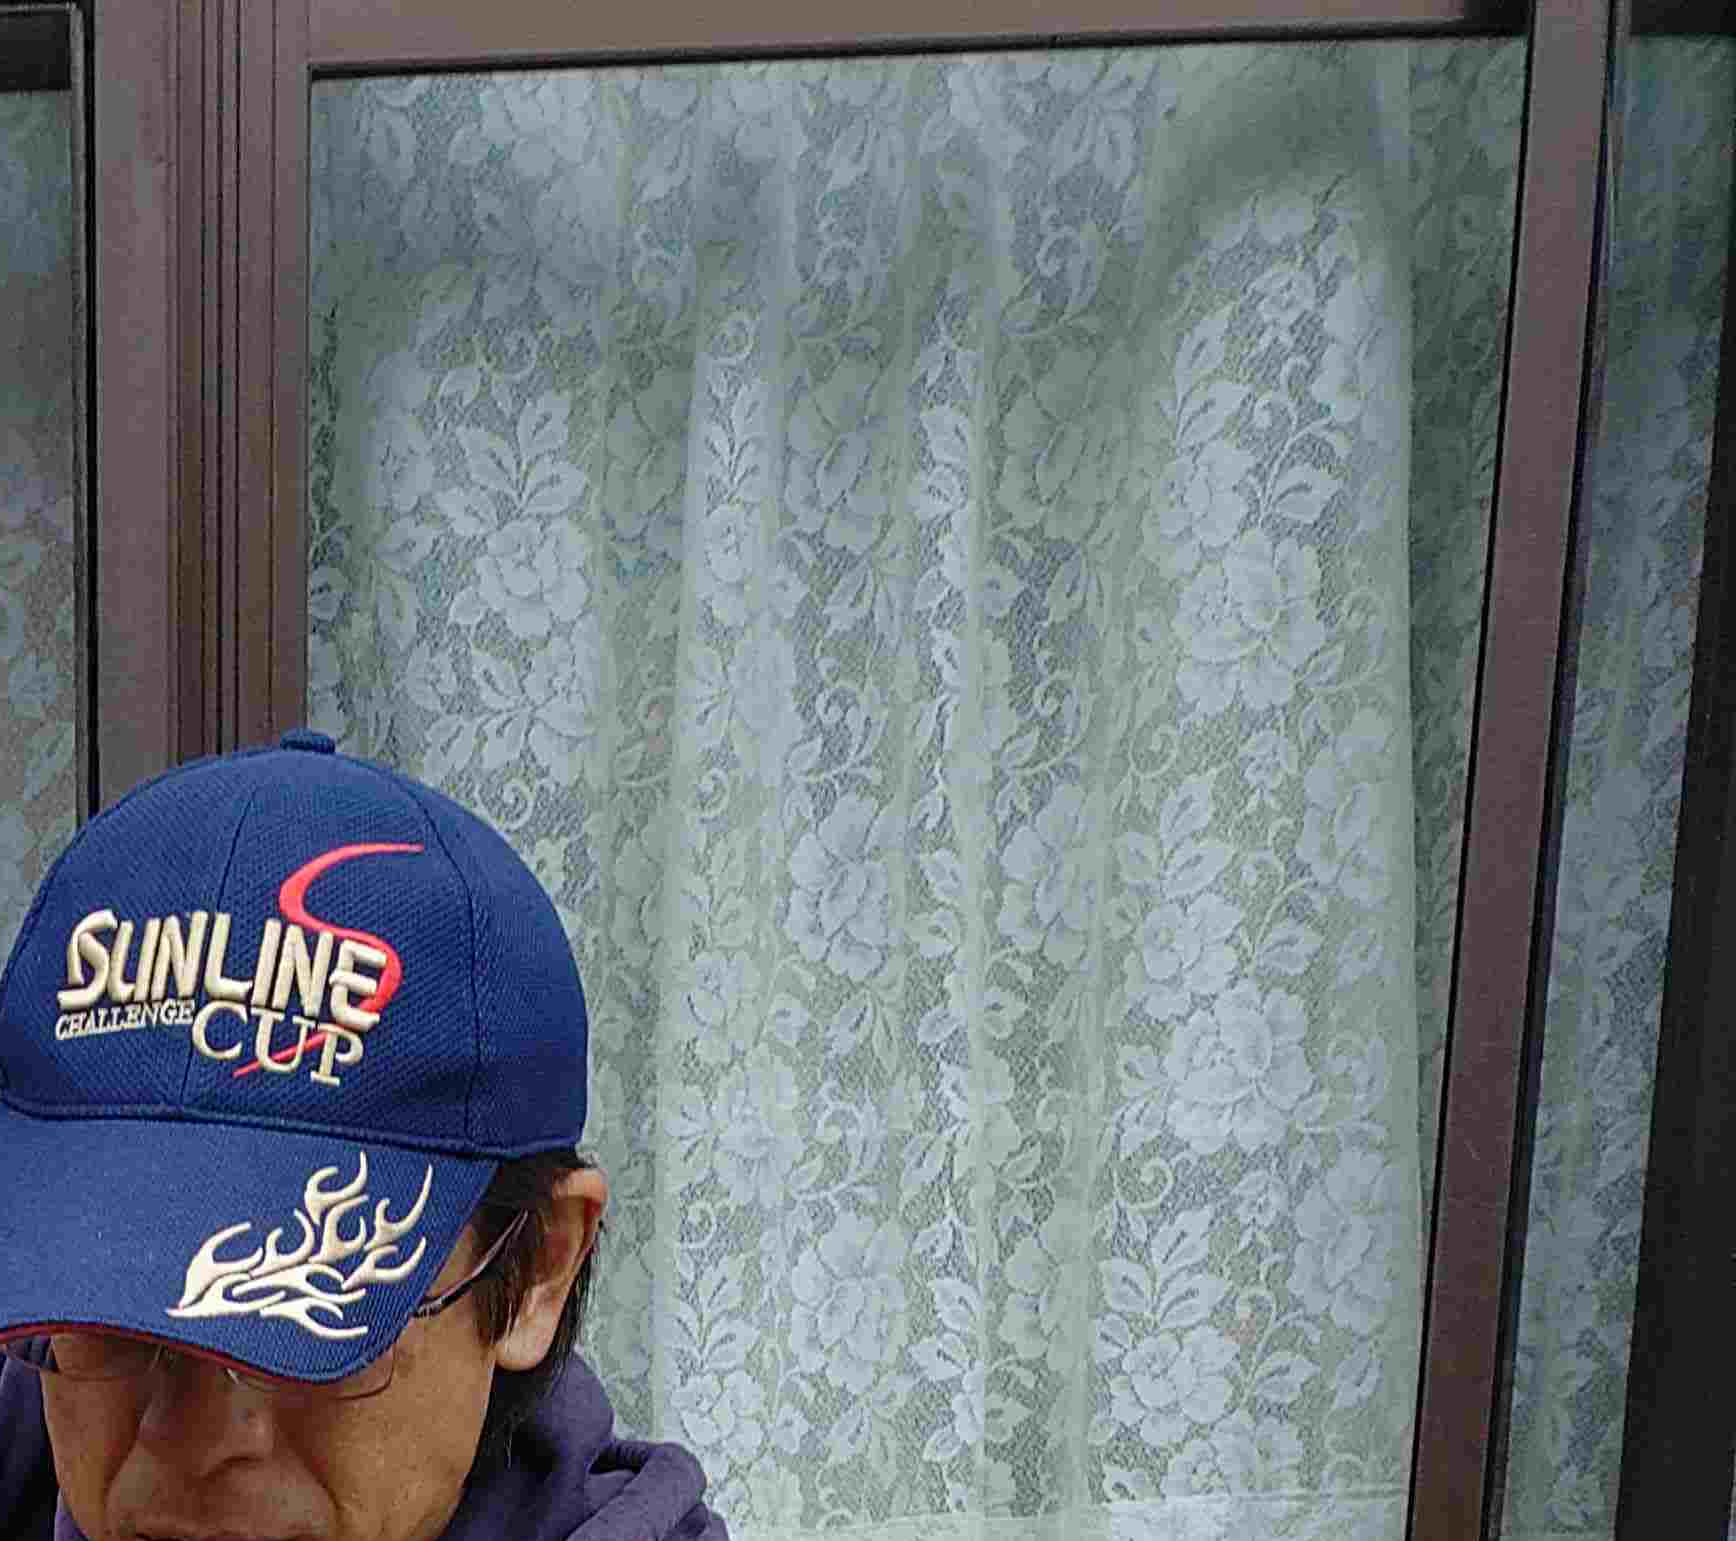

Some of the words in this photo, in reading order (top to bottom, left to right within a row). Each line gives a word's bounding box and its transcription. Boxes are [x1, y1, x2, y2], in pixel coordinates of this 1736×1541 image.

[57, 909, 386, 1031] SUNLINE
[55, 1000, 196, 1041] CHALLENGE
[192, 1001, 364, 1086] CUP
